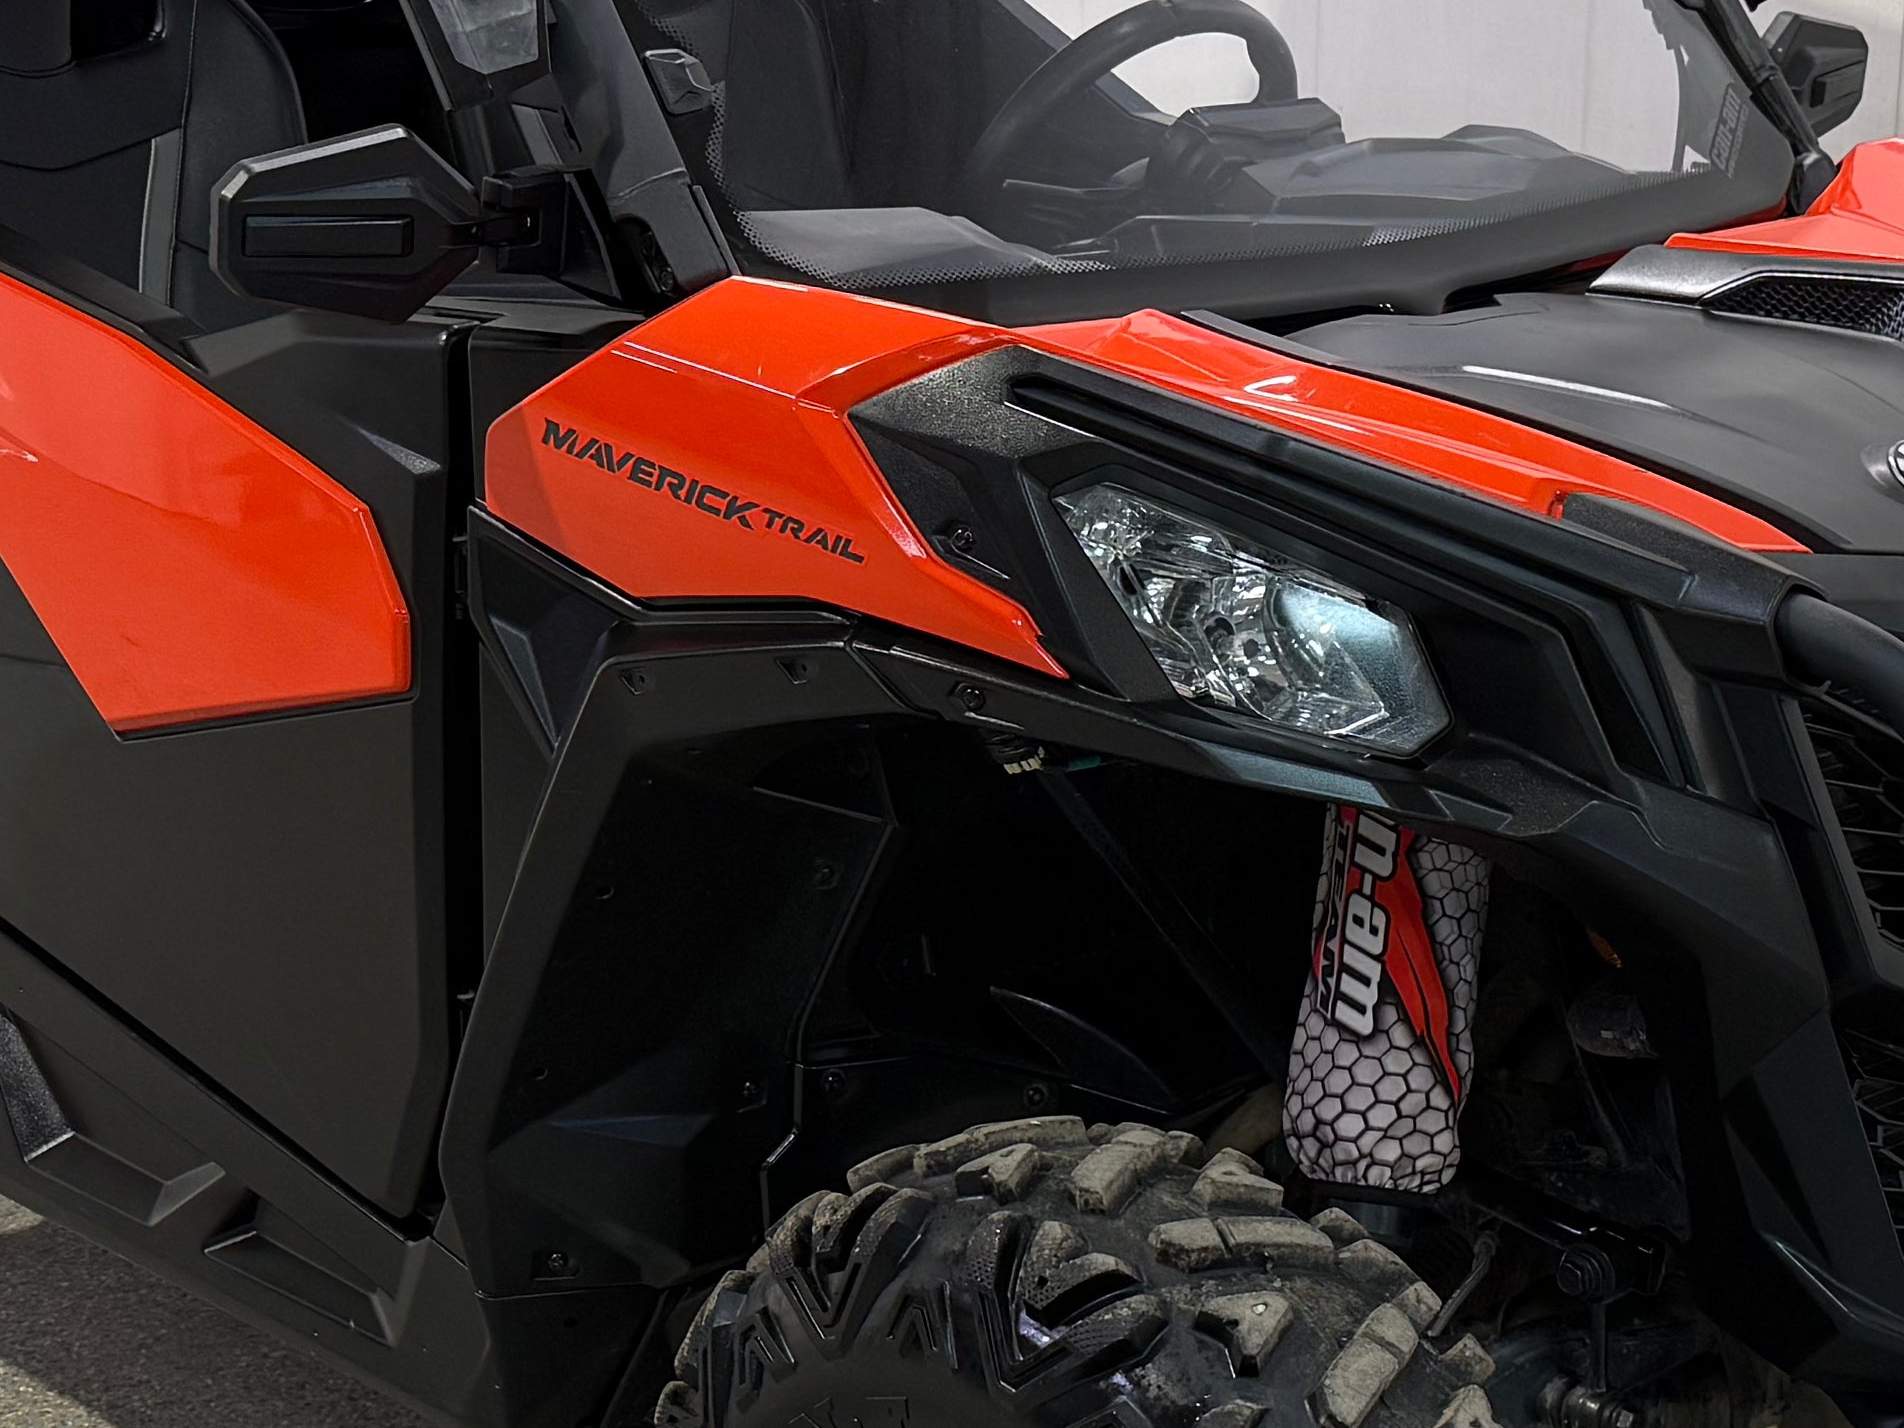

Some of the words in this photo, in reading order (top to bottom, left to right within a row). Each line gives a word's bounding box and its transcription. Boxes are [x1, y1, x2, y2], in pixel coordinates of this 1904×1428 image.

[1711, 87, 1742, 171] can-am
[541, 417, 760, 531] MAVERICK
[759, 507, 865, 564] TRAIL
